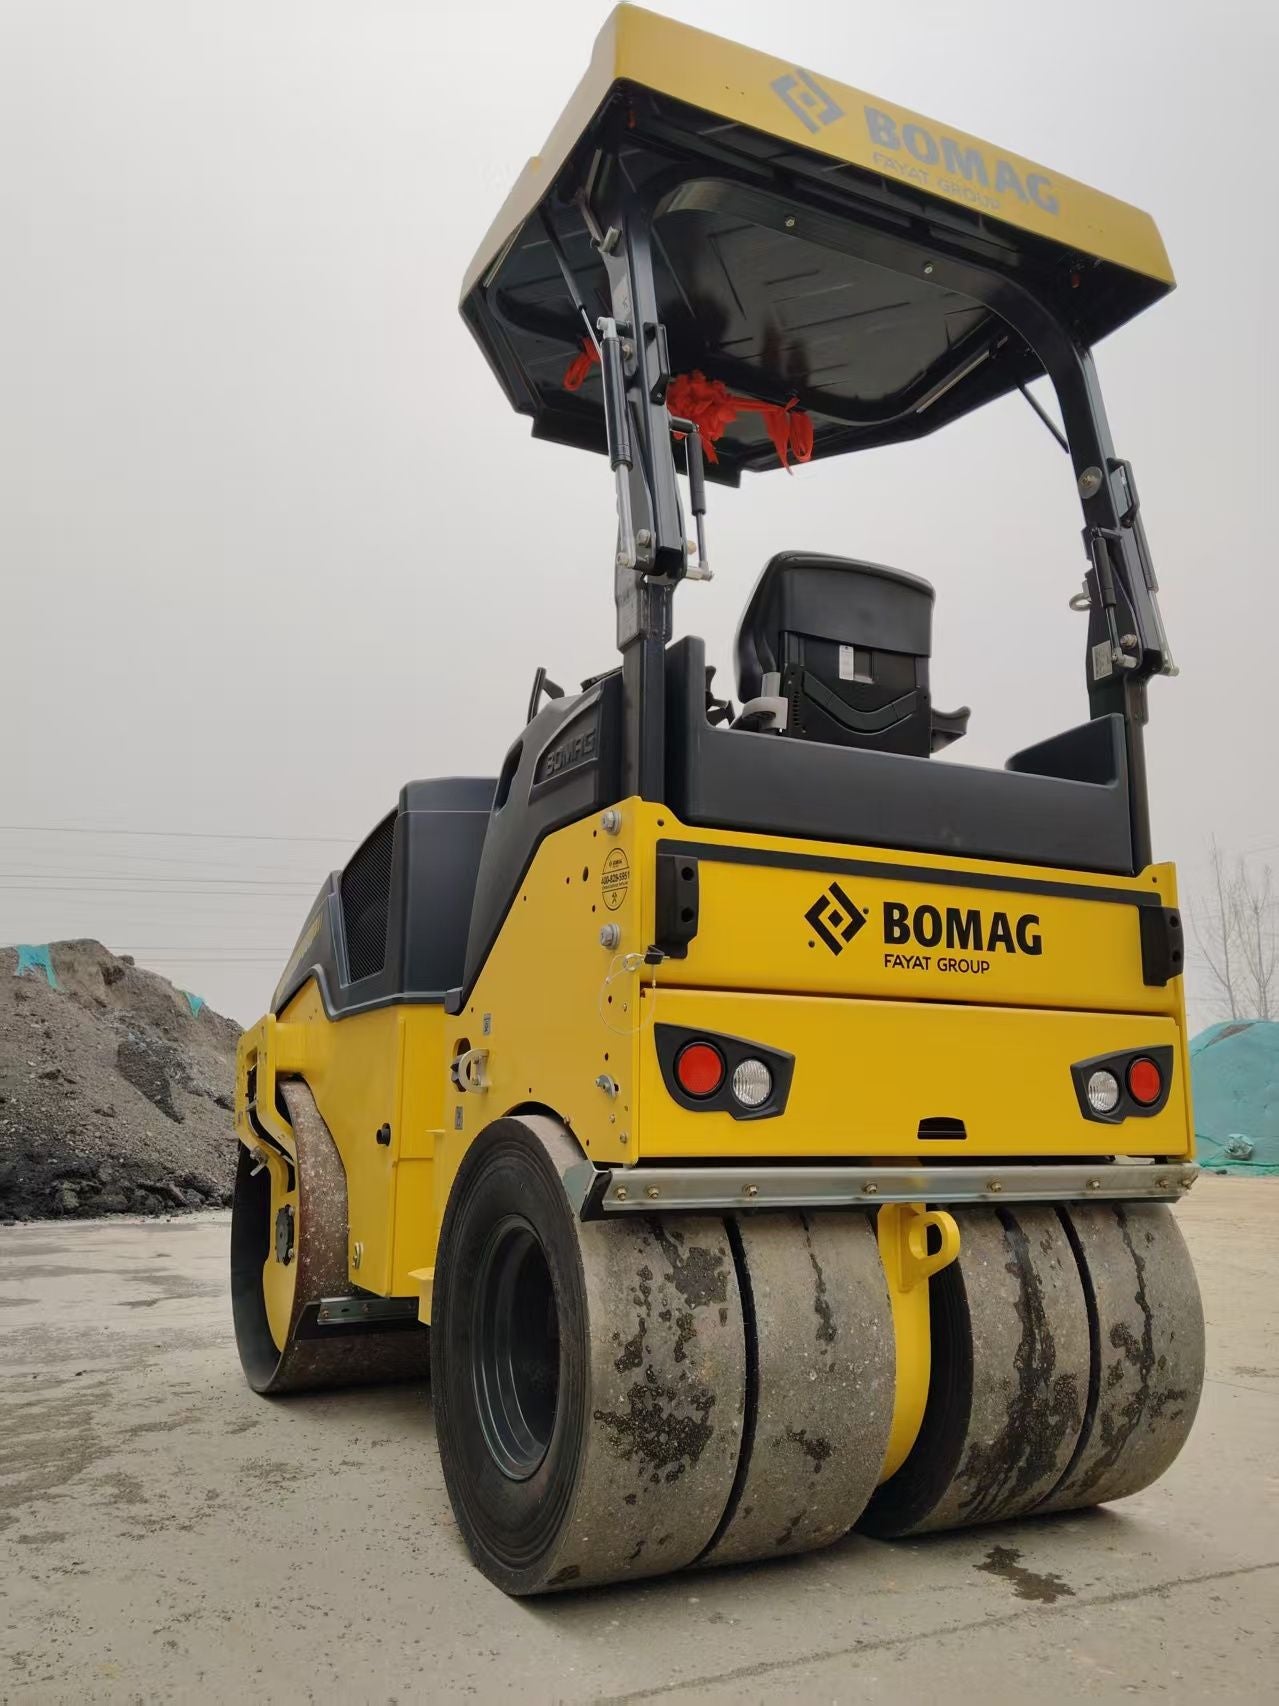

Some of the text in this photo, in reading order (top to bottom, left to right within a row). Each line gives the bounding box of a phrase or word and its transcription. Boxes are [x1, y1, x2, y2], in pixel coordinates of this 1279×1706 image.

[865, 105, 1058, 215] BOMAG
[873, 152, 1000, 208] FAYAT GROUP
[884, 902, 1042, 955] BOMAG
[884, 954, 990, 974] FAYAT GROUP
